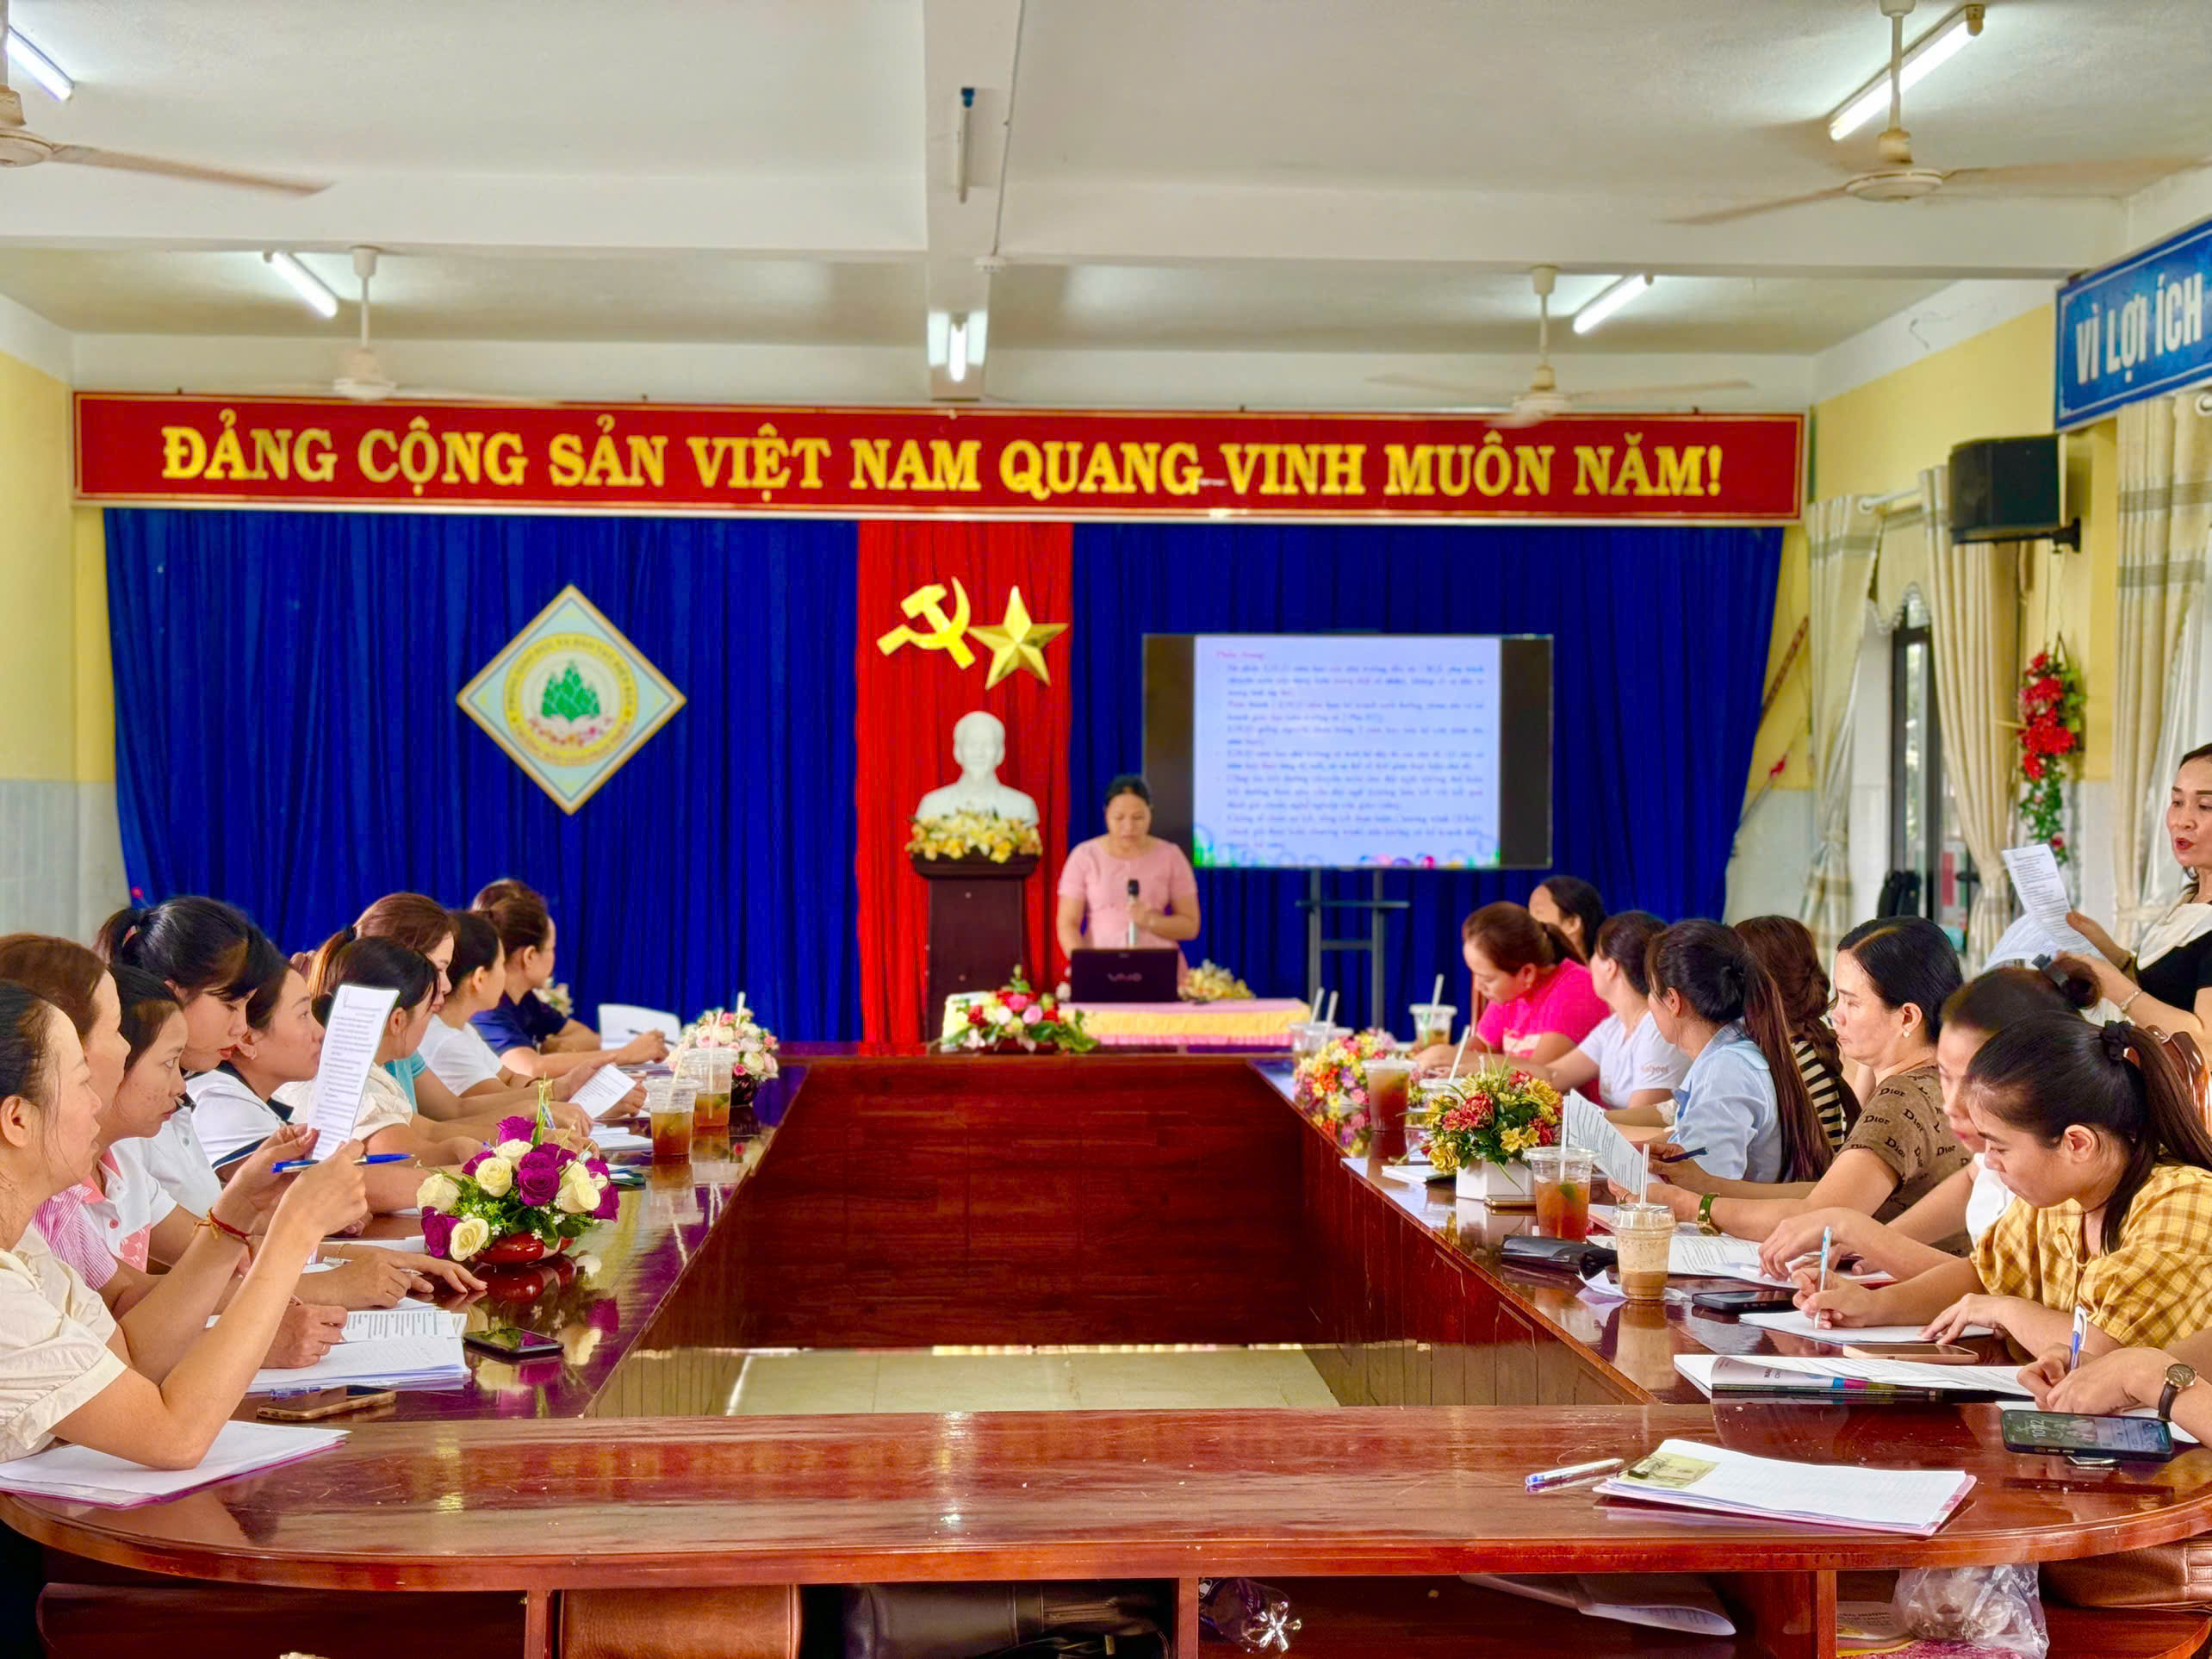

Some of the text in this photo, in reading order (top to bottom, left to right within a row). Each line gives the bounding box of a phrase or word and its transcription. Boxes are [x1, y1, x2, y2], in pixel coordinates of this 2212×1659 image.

[2075, 272, 2203, 386] VÌ LỢI ÍCH
[161, 410, 1723, 501] ĐẢNG CỘNG SẢN VIỆT NAM QUANG VINH MUÔN NĂM!
